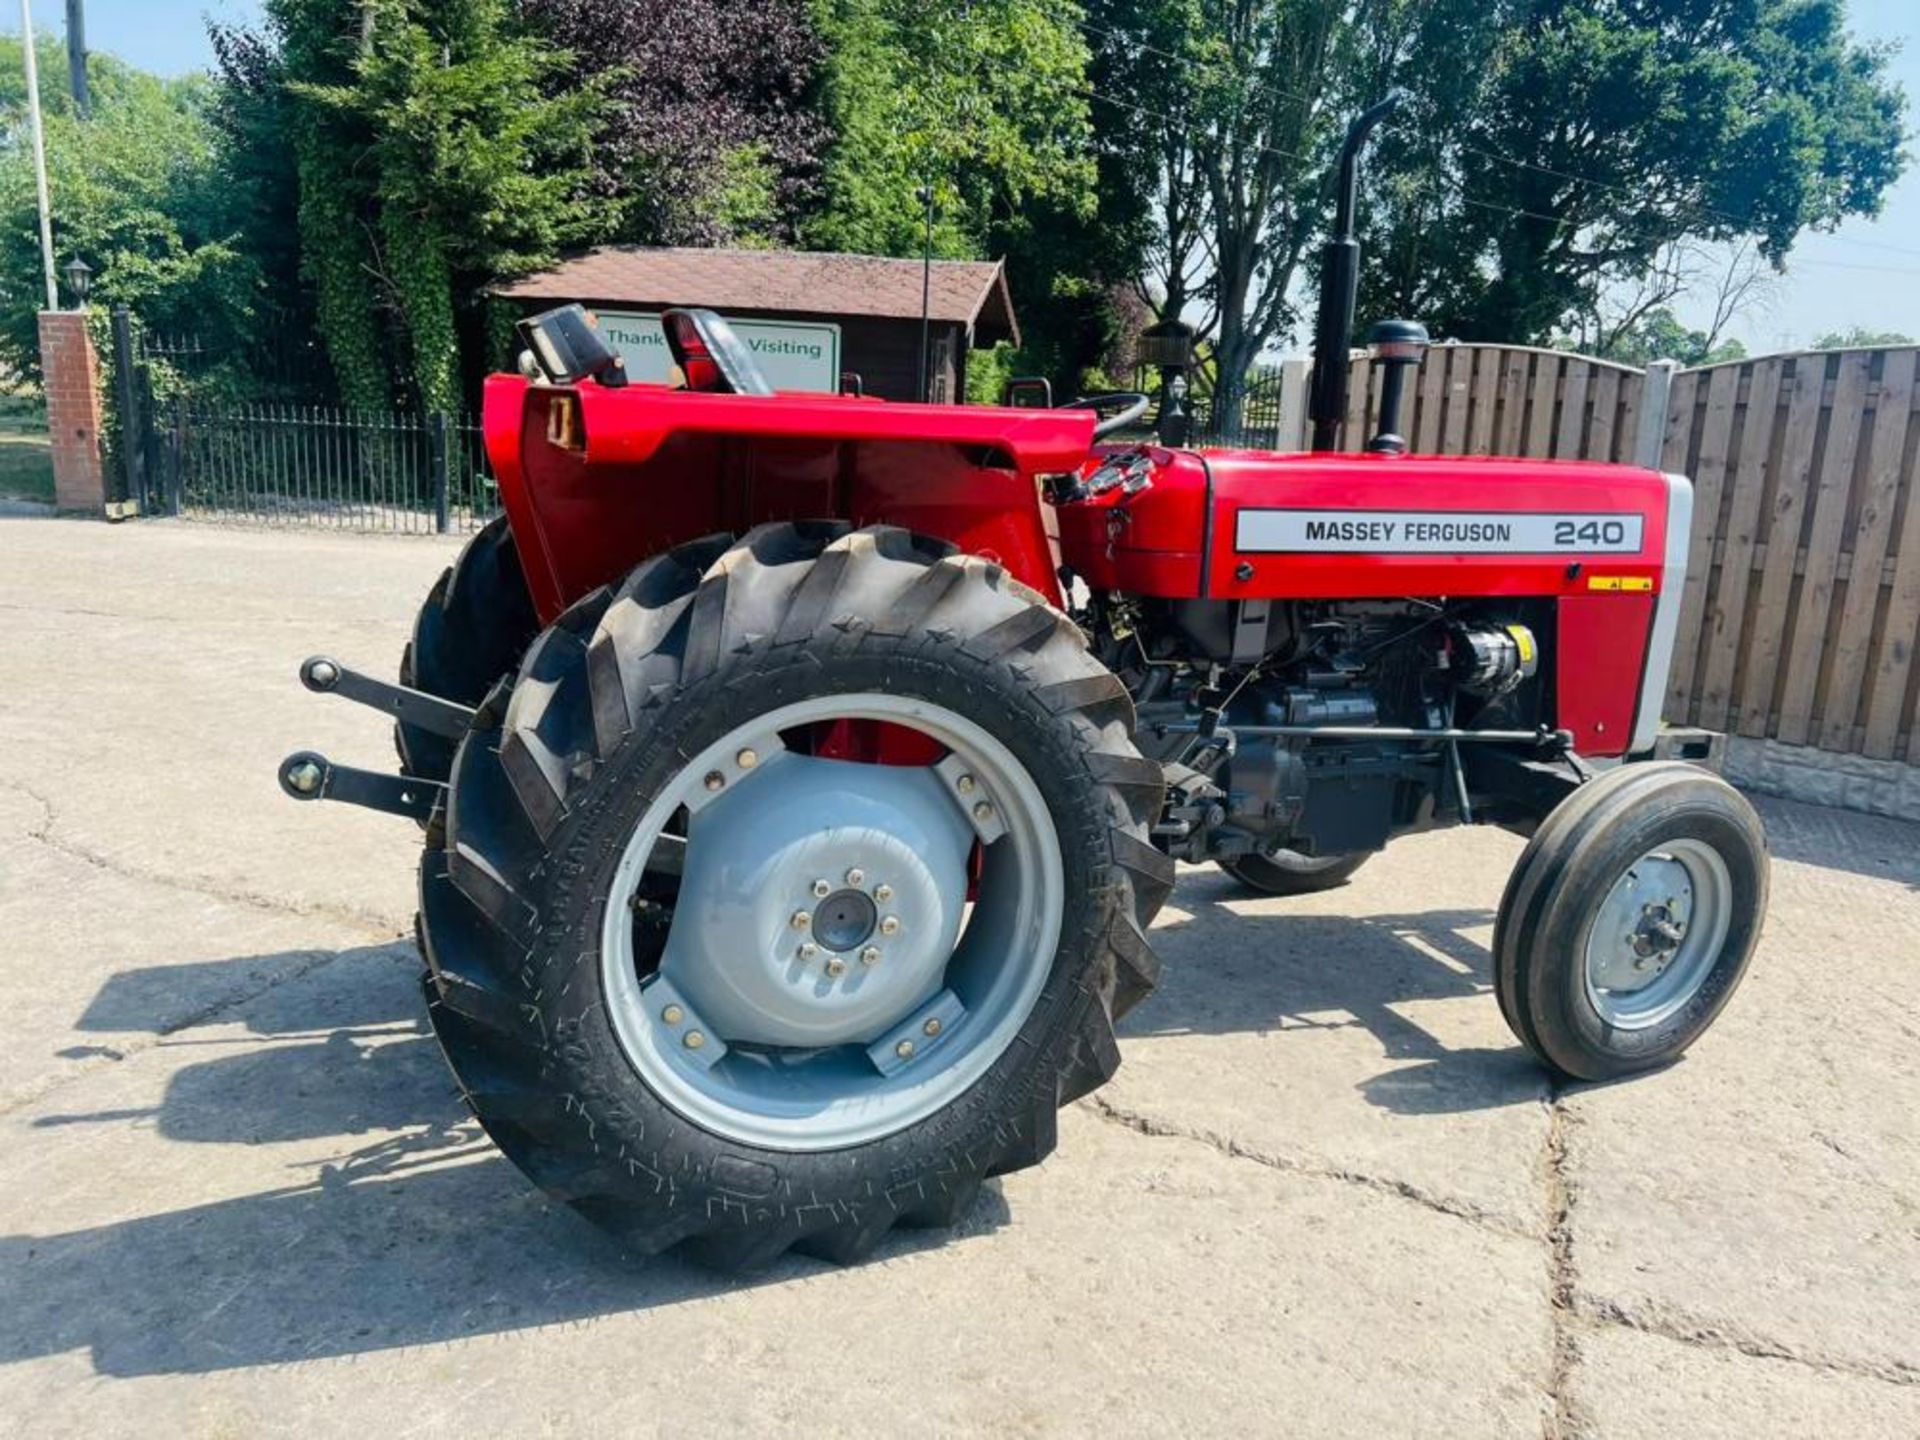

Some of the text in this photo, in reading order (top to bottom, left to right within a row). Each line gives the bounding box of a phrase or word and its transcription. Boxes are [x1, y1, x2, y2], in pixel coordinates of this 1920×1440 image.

[606, 329, 664, 346] Thank
[748, 338, 822, 359] Visiting
[1305, 521, 1625, 545] MASSEY FERGUSON 240
